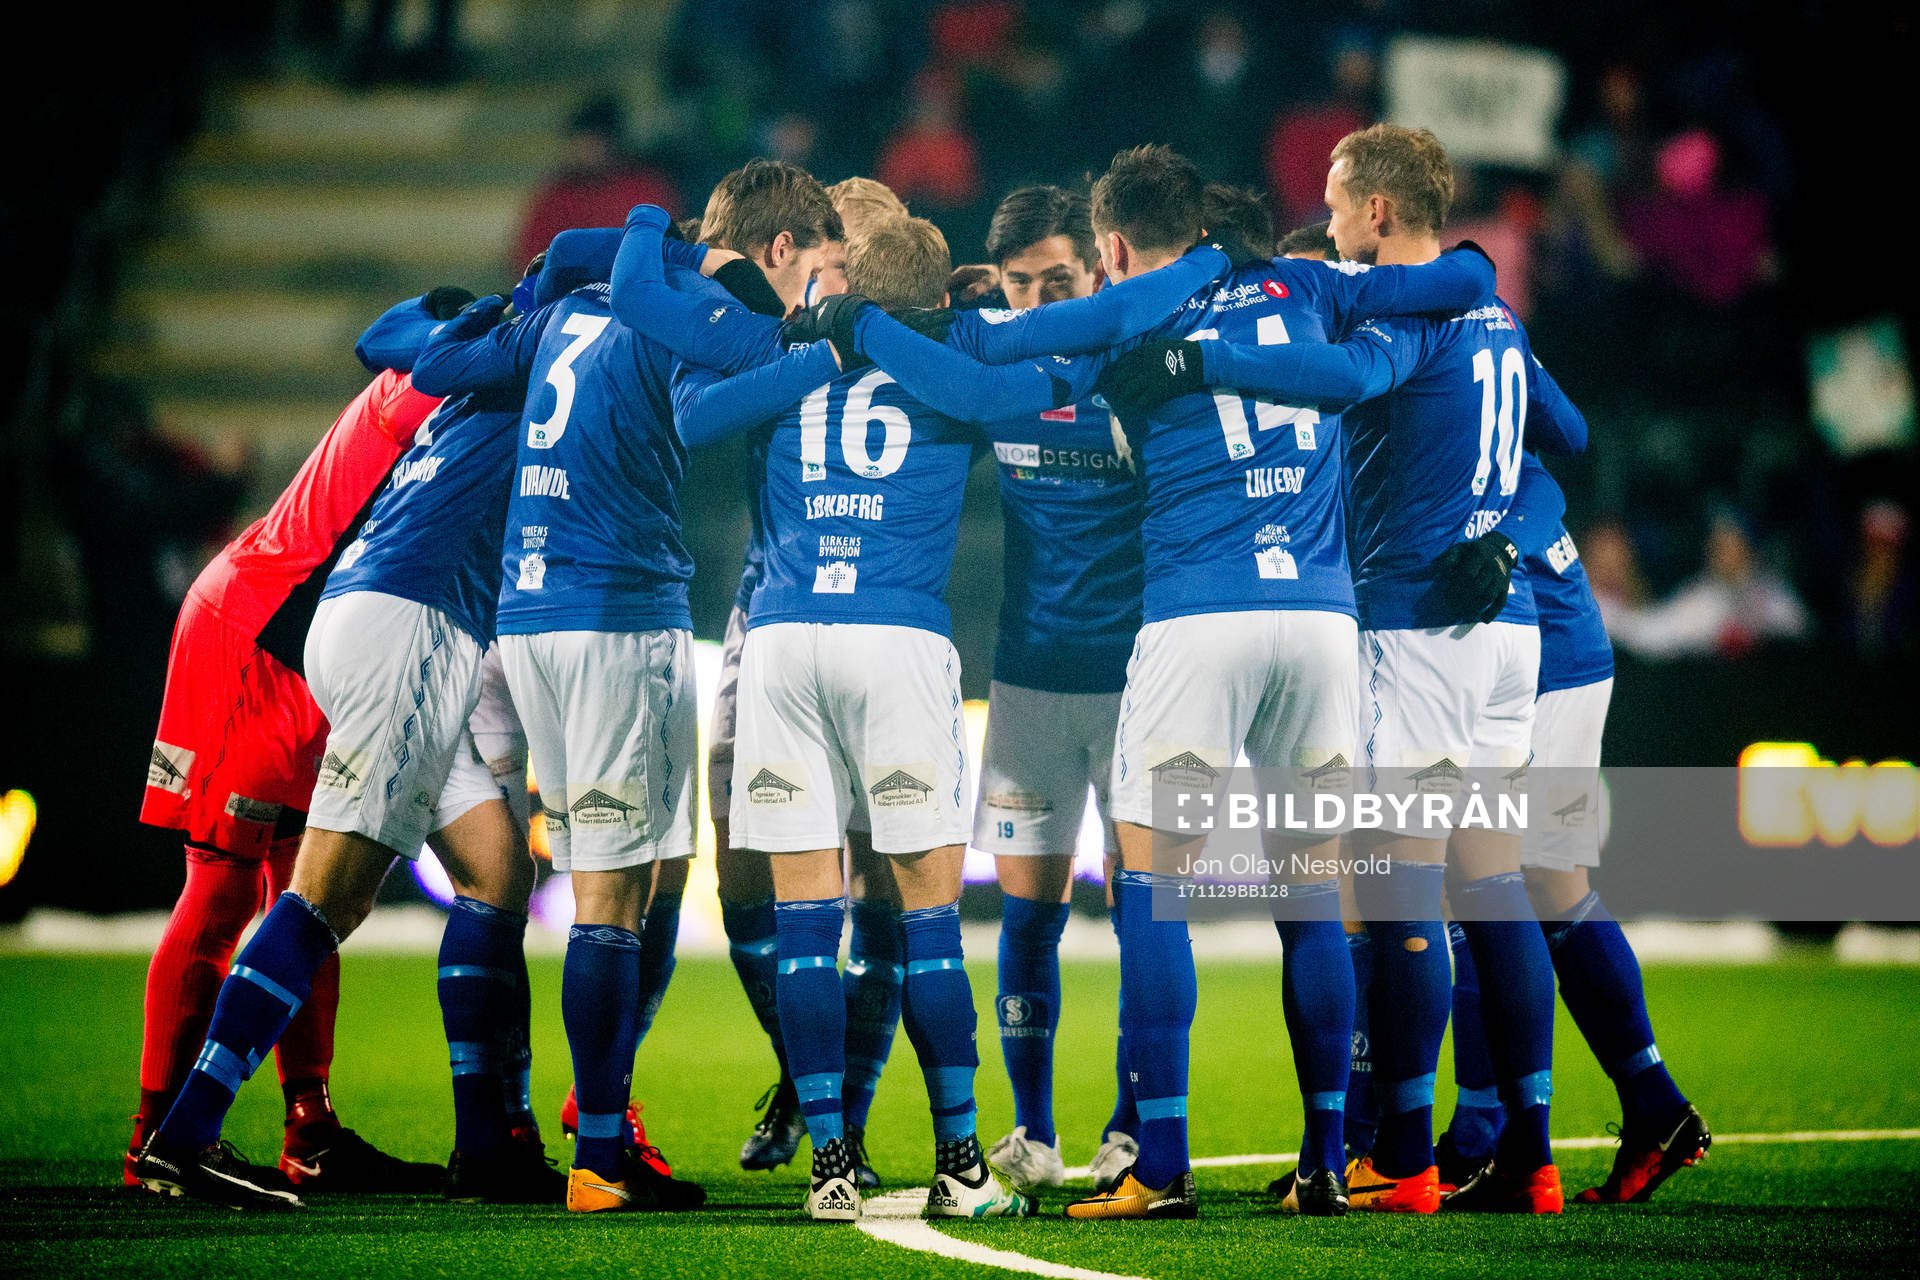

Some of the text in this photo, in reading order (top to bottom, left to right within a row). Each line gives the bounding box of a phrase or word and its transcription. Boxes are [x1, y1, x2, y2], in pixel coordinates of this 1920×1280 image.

[527, 312, 613, 450] 3
[800, 368, 912, 482] 16
[1471, 347, 1528, 496] 10
[804, 493, 884, 521] LØKBERG
[819, 535, 862, 547] KIRKENS
[818, 546, 861, 559] BYMISJON
[997, 821, 1014, 839] 19
[818, 1200, 856, 1211] adidas
[929, 1196, 958, 1208] didas
